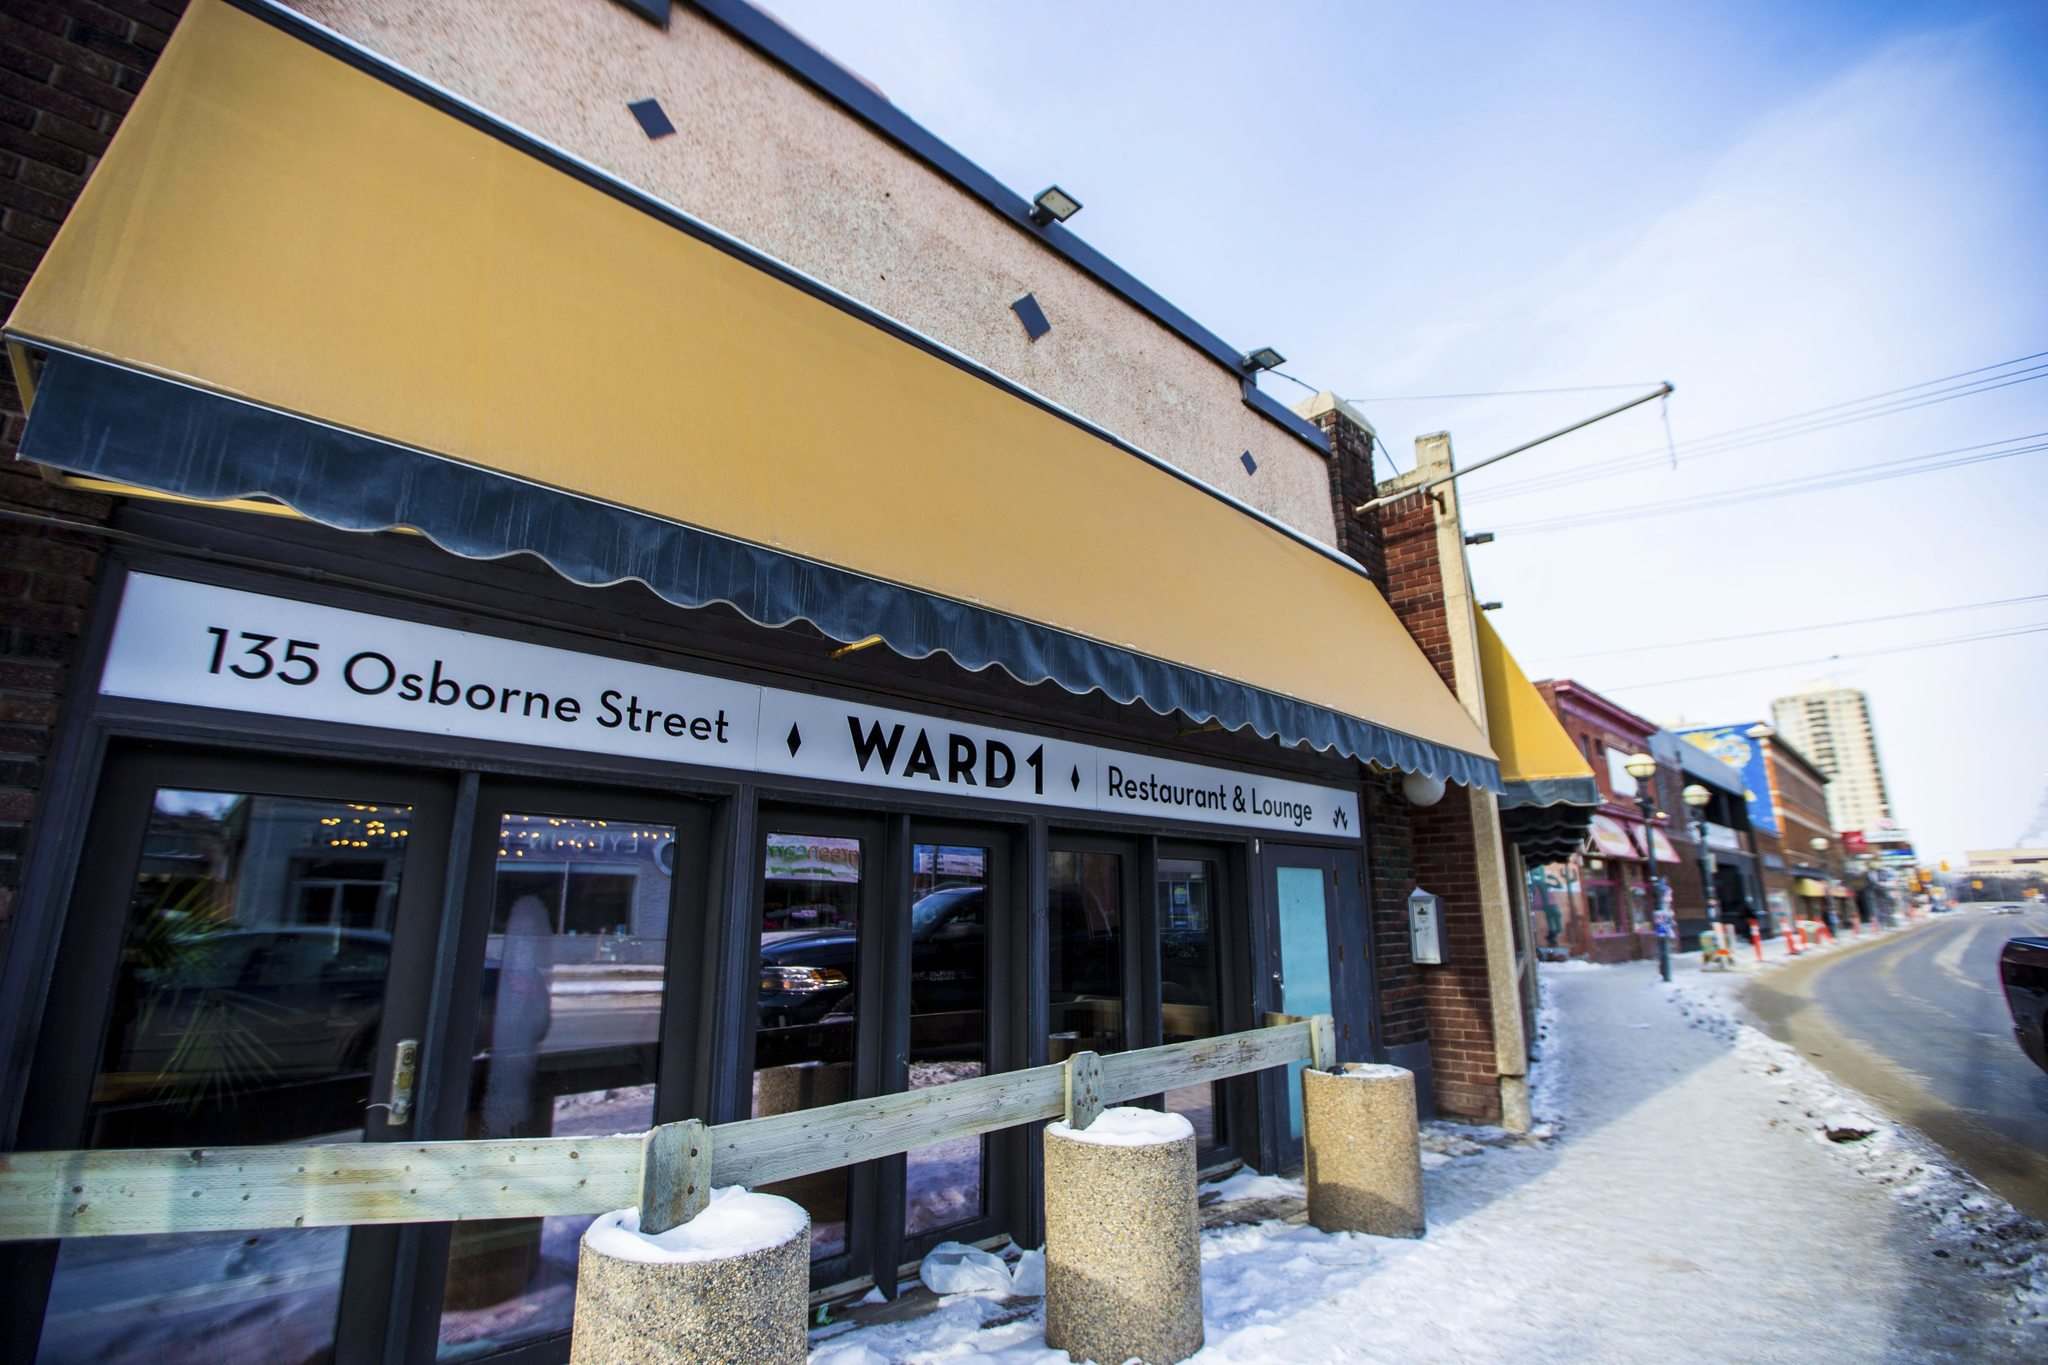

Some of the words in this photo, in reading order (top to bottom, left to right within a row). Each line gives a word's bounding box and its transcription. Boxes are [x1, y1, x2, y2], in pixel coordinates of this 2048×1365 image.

[207, 626, 320, 686] 135
[343, 652, 581, 723] Osborne
[595, 690, 729, 744] Street
[1108, 765, 1228, 812] Restaurant
[1231, 784, 1247, 814] &
[1252, 786, 1313, 828] Lounge
